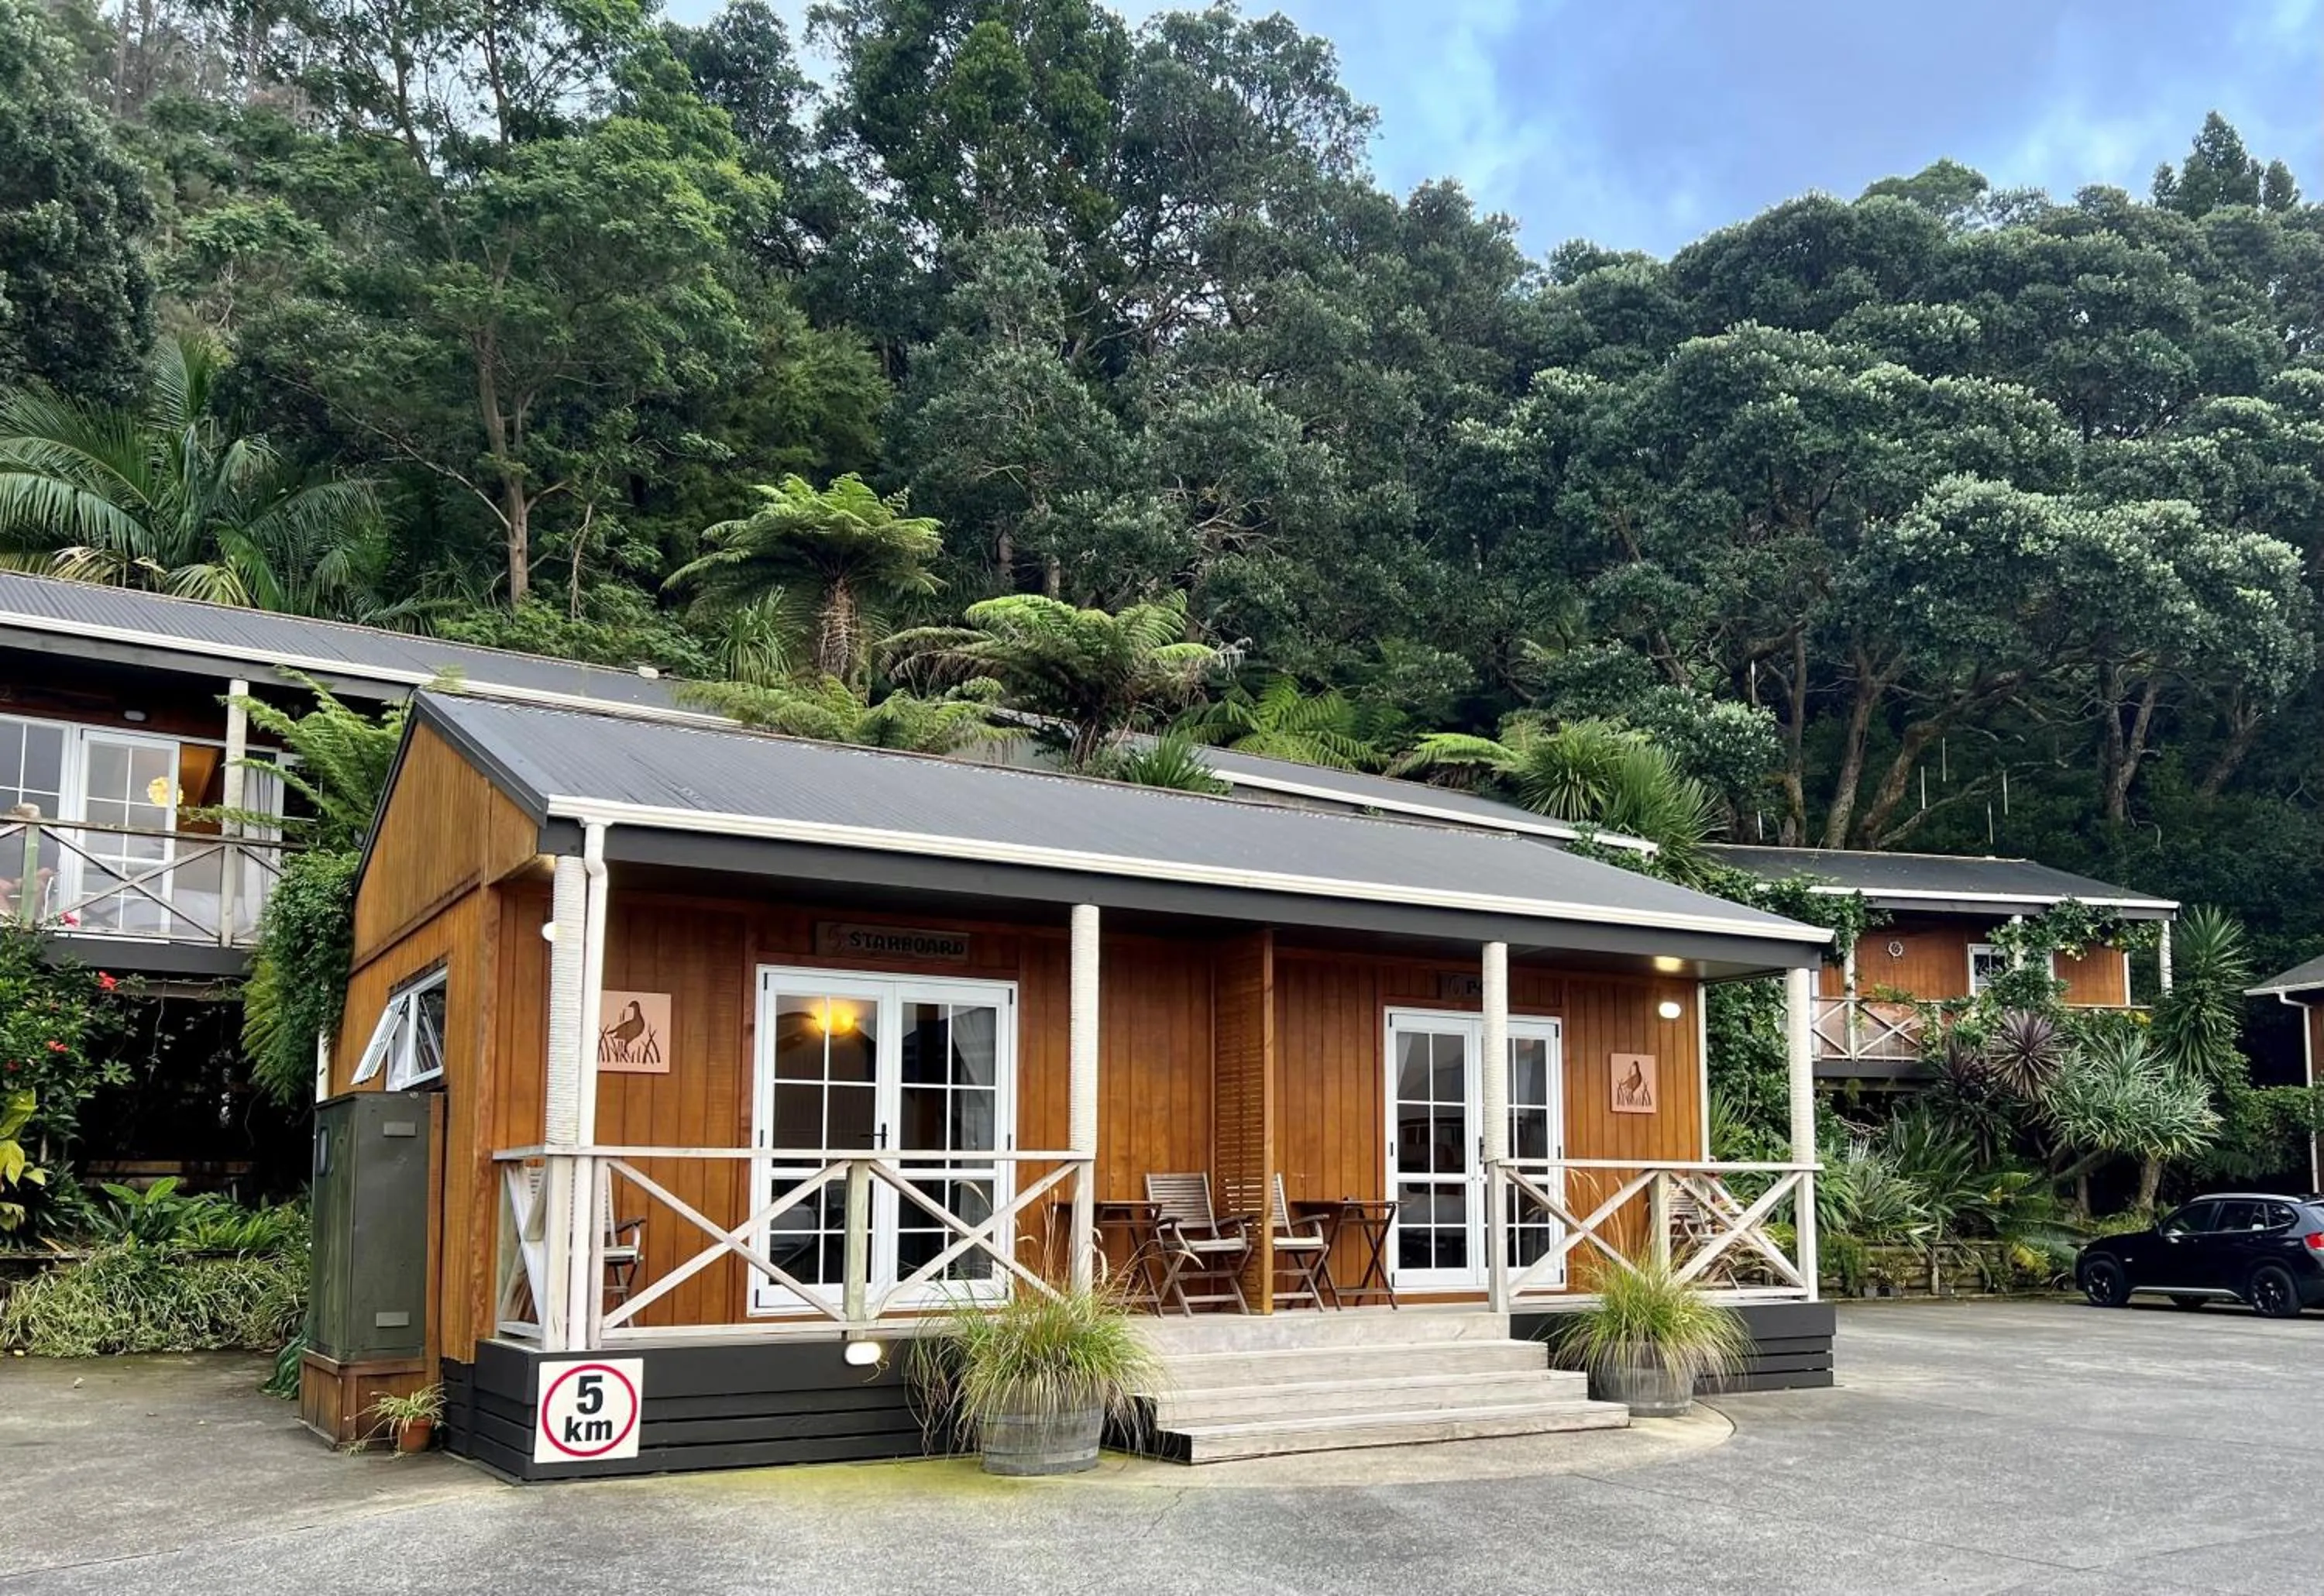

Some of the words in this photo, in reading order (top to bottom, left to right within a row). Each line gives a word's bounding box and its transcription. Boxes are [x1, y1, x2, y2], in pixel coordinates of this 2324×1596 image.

[849, 930, 964, 955] STARBOARD
[576, 1375, 603, 1415] 5
[564, 1415, 613, 1443] km
